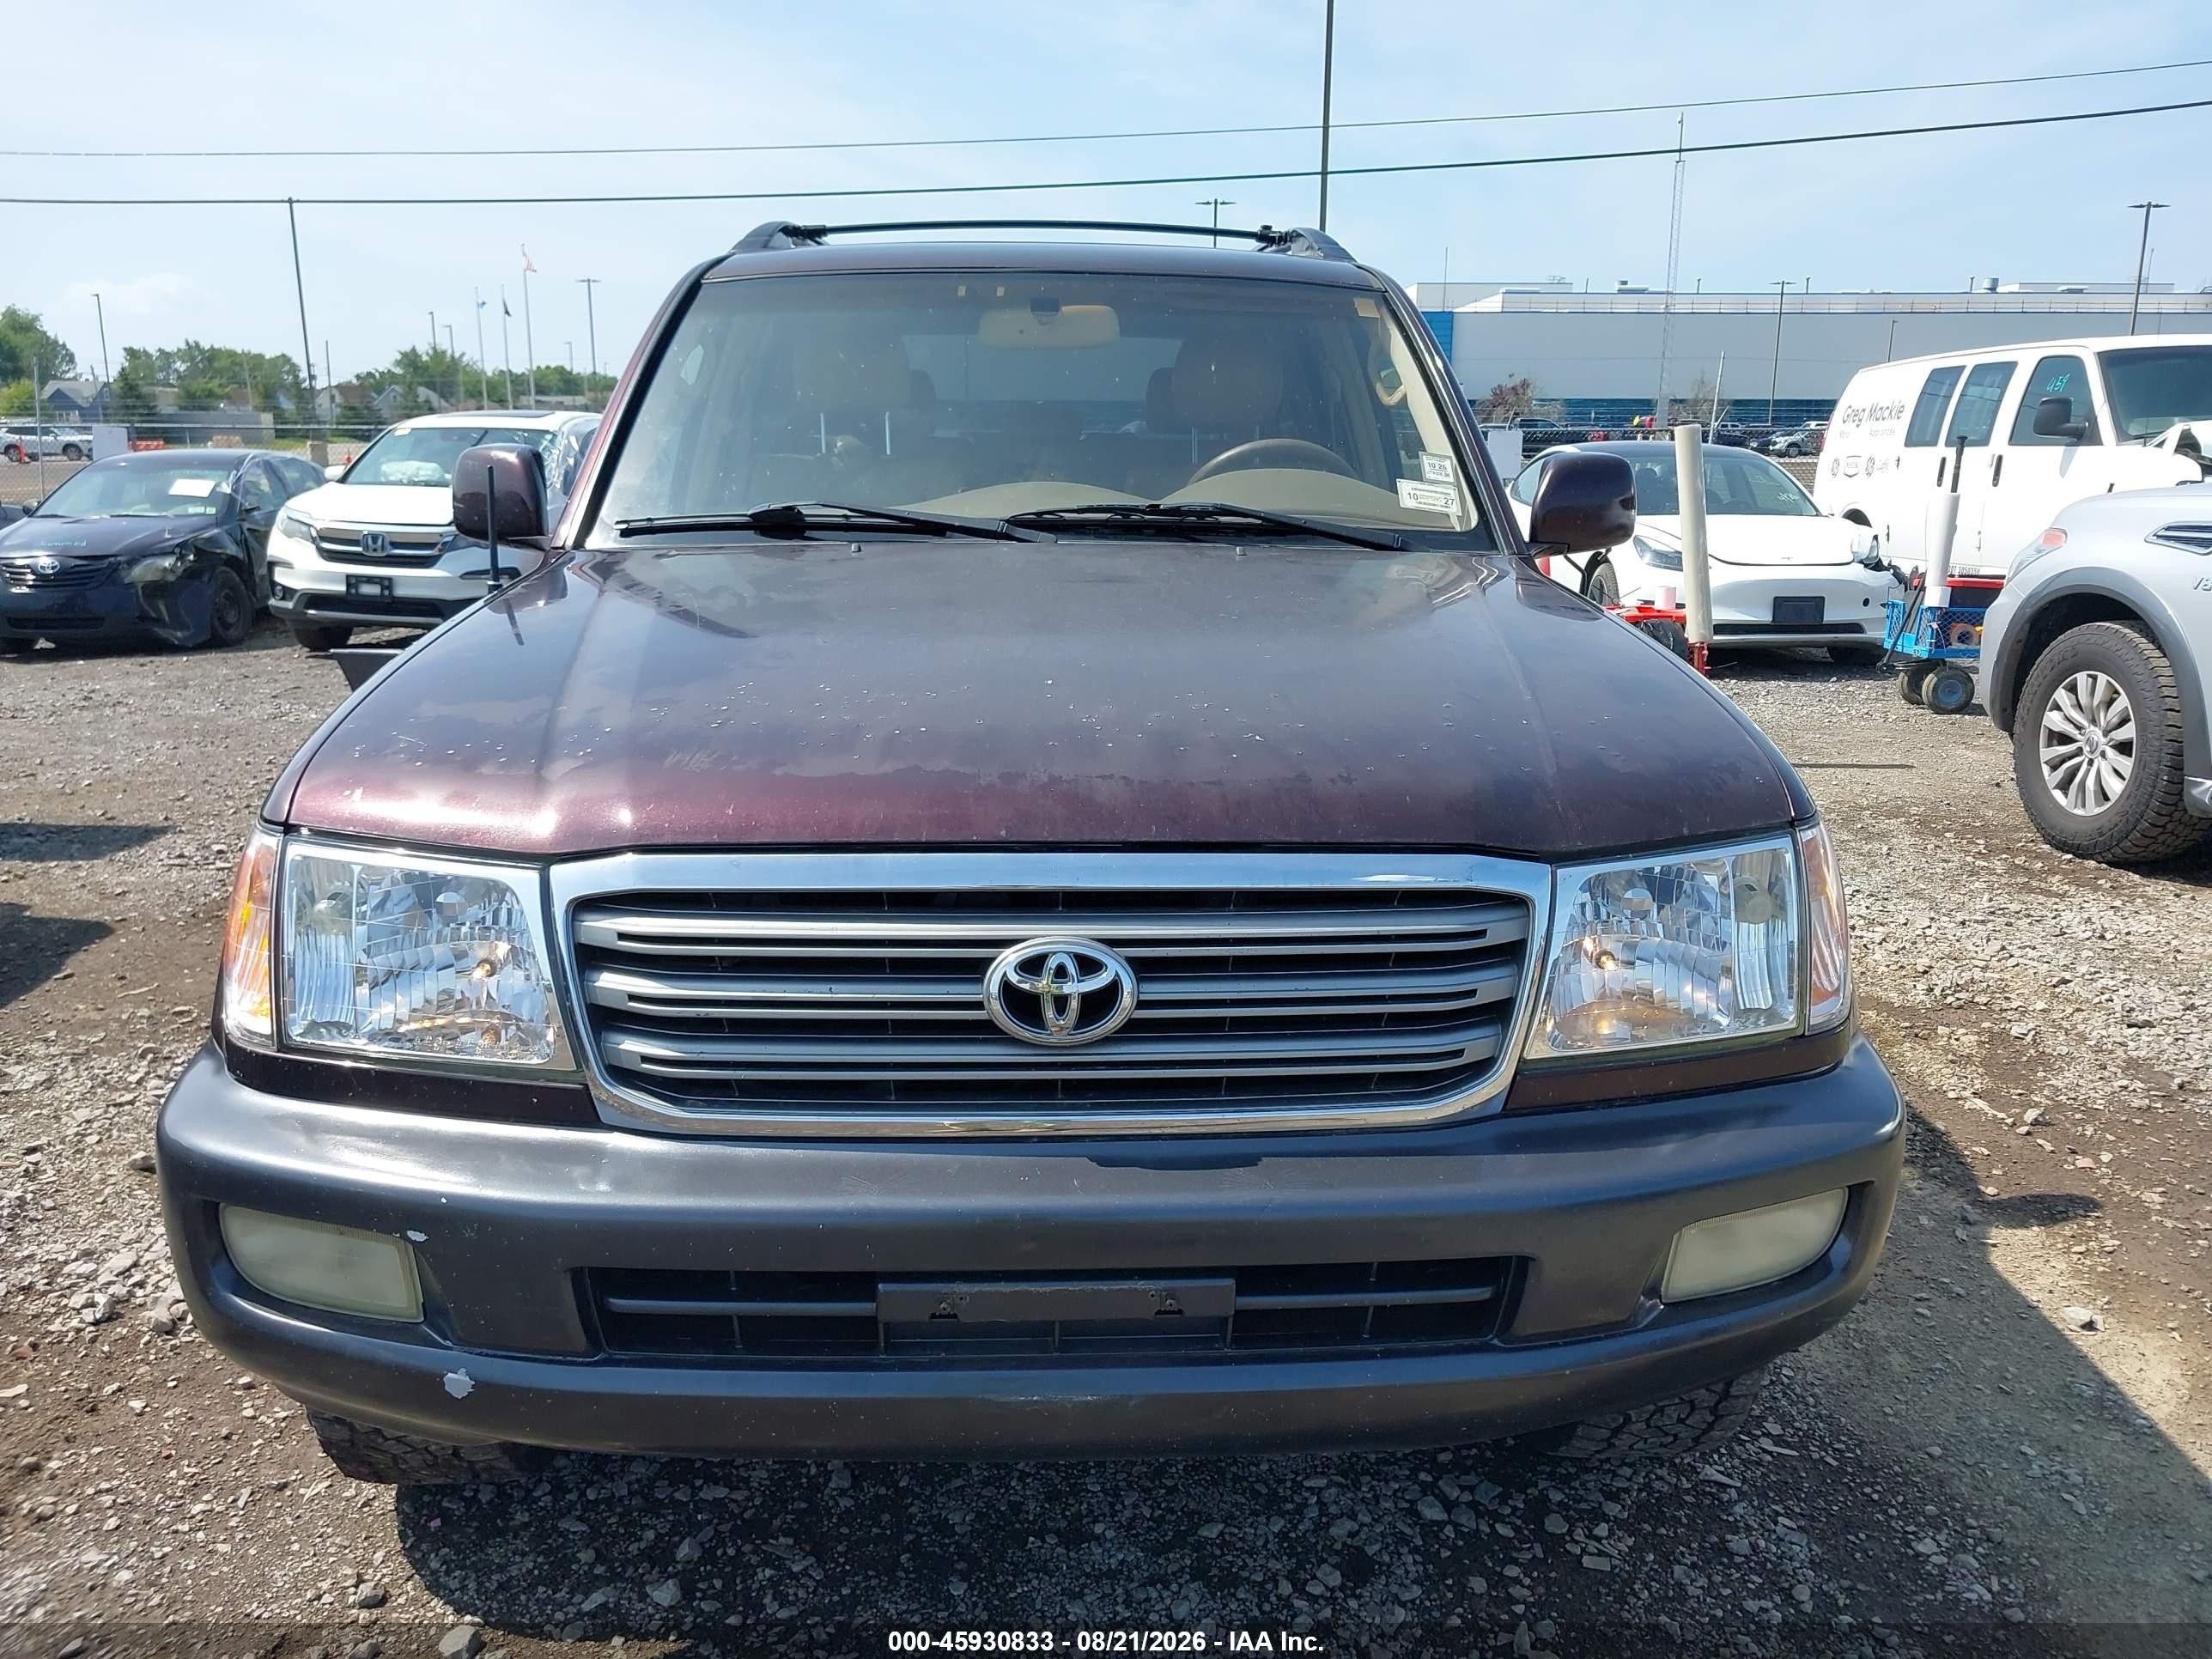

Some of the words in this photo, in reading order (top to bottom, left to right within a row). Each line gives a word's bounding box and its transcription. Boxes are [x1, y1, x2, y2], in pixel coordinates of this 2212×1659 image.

[1843, 405, 1866, 428] Greg
[1866, 399, 1905, 422] Mackie
[1407, 492, 1419, 501] 10
[1443, 497, 1455, 507] 27
